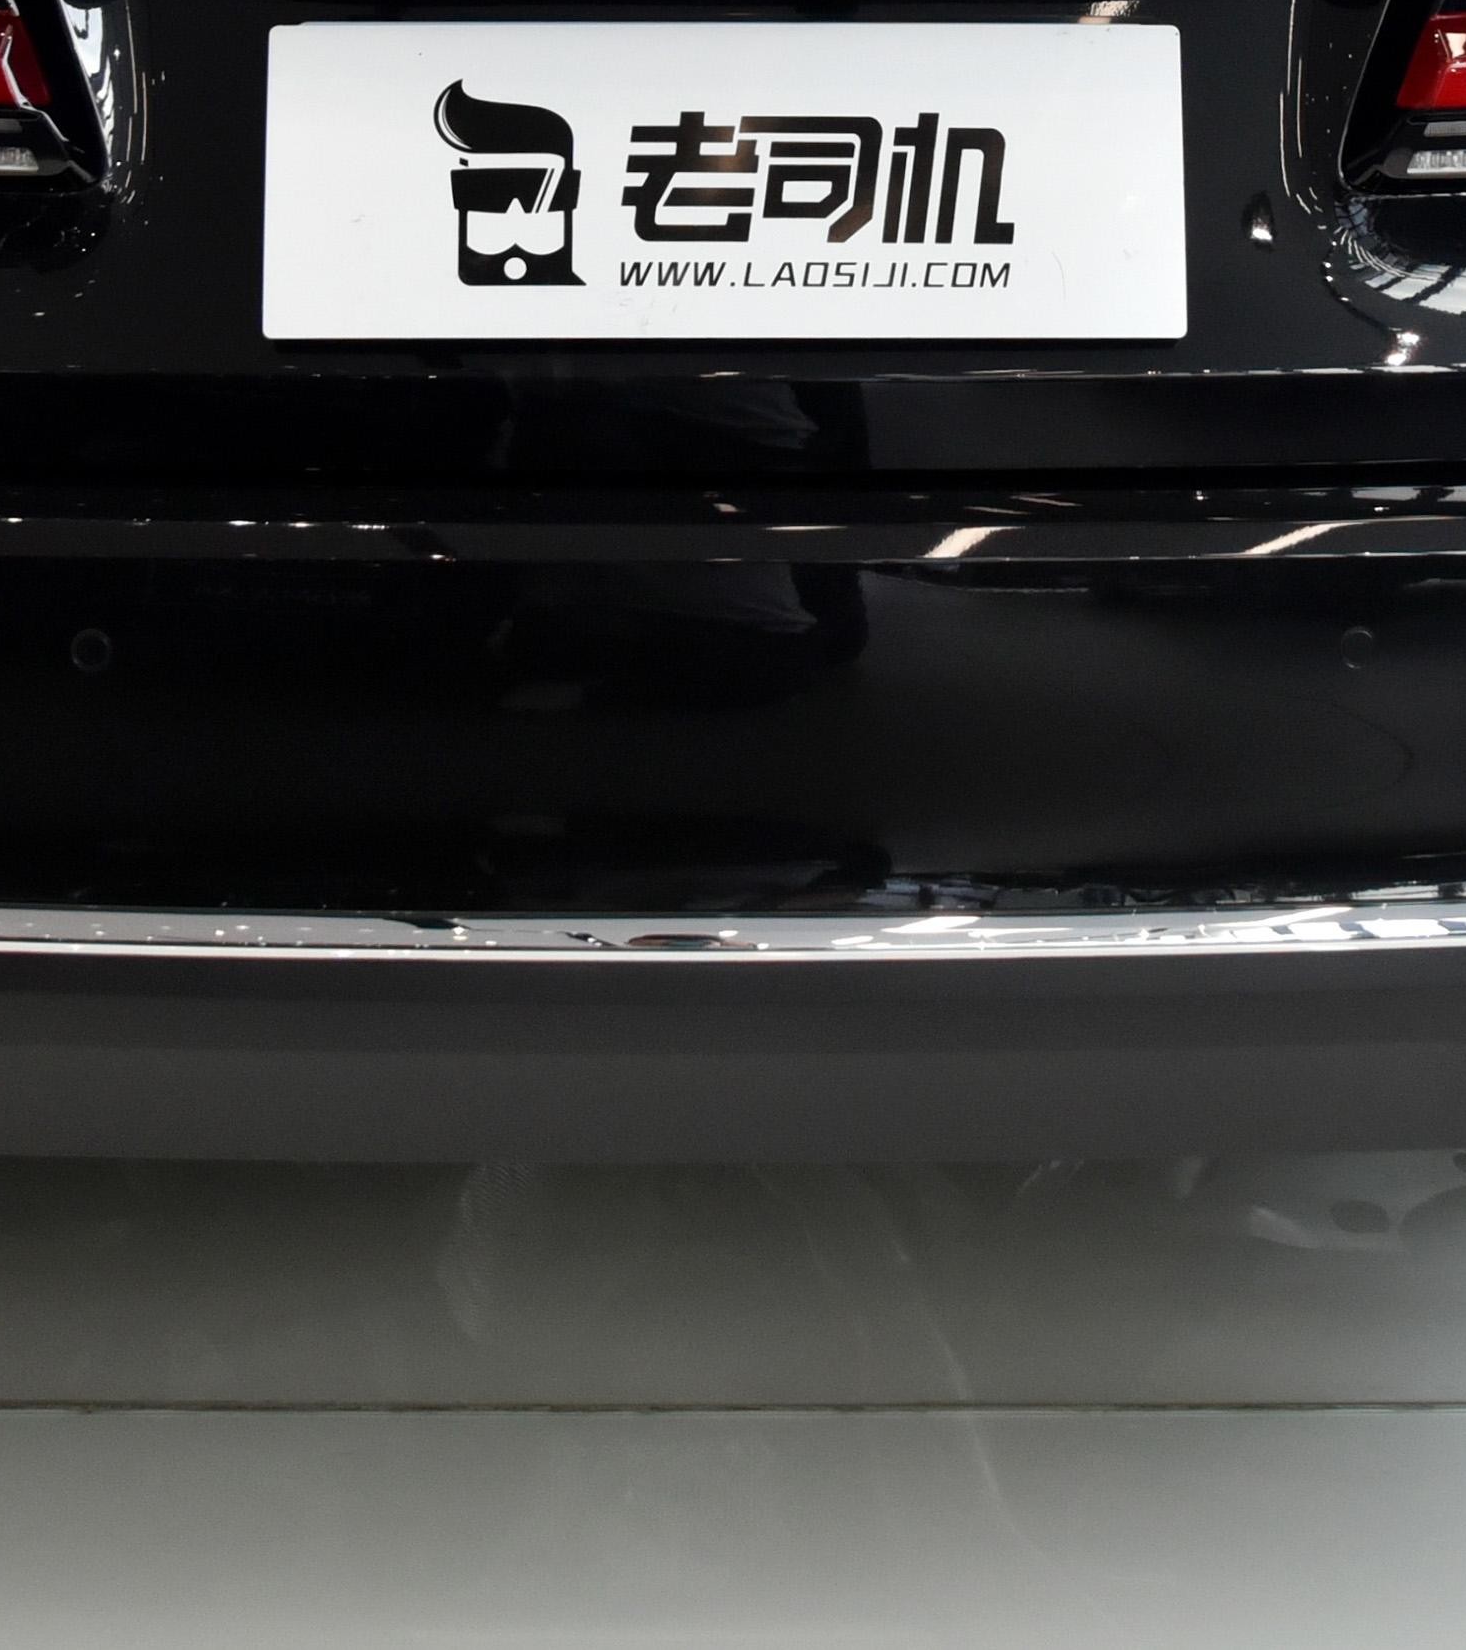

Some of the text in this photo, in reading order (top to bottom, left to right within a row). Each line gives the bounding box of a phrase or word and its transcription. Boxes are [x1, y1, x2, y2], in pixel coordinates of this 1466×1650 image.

[620, 110, 1015, 245] 老司机
[619, 260, 1012, 289] WWW.LAOSIJI.COM
